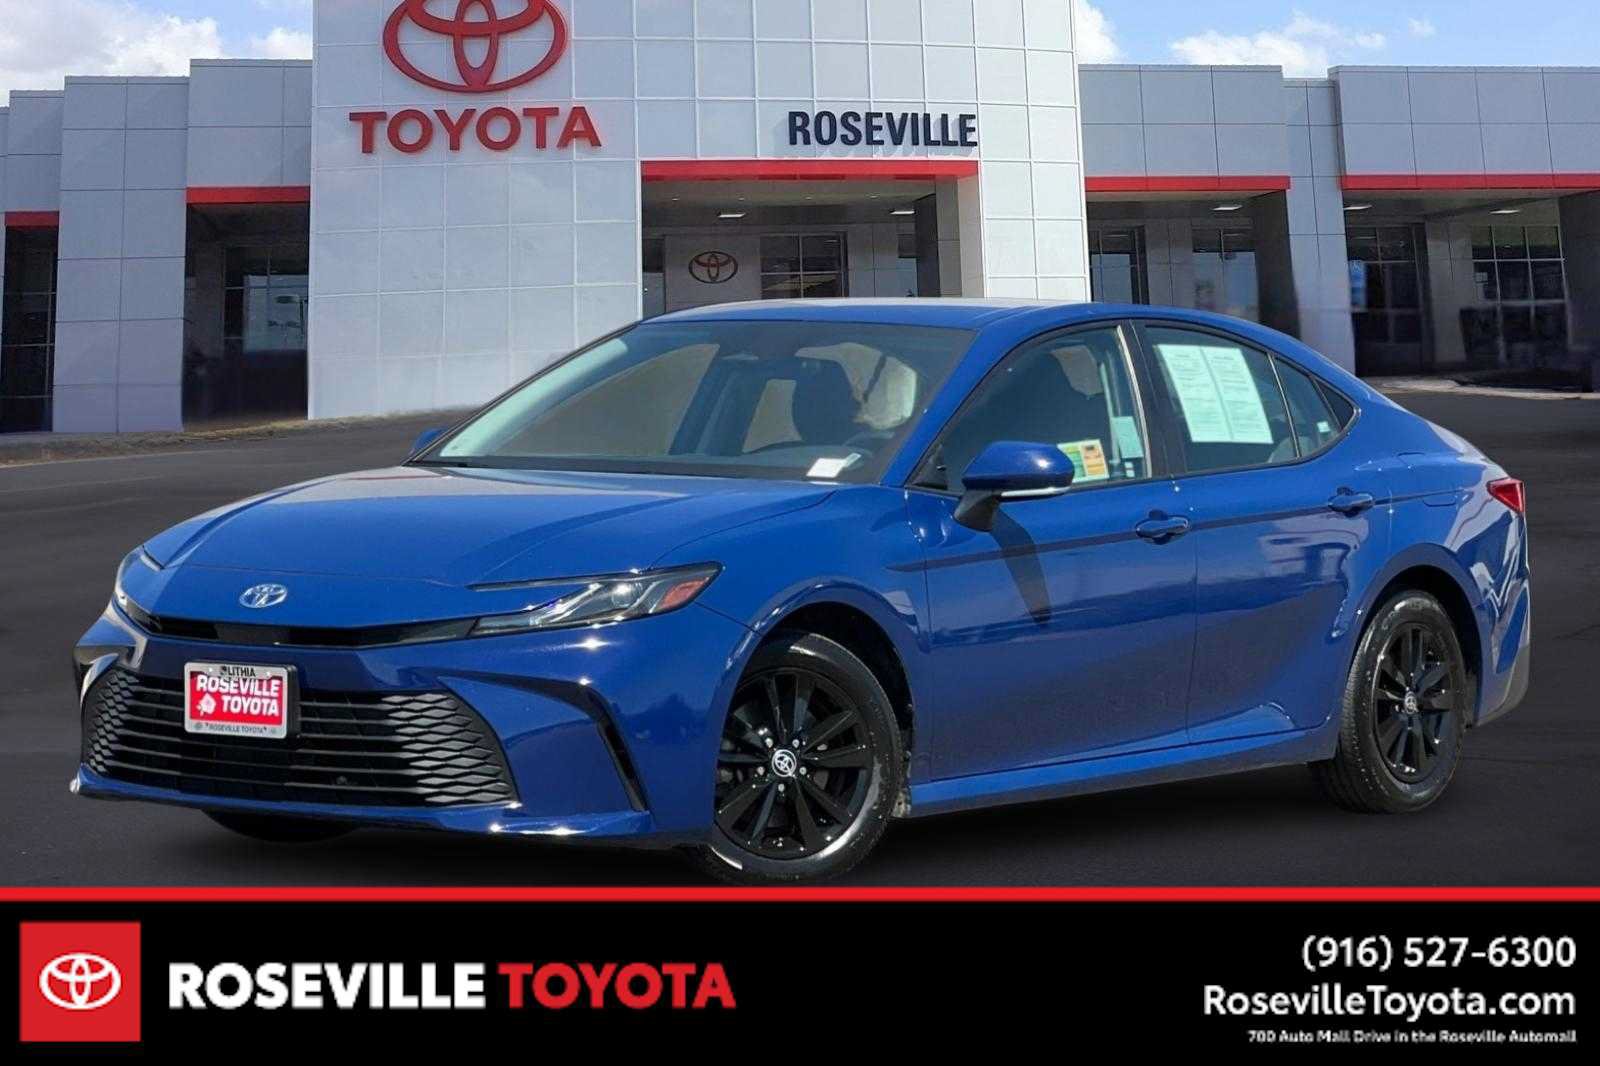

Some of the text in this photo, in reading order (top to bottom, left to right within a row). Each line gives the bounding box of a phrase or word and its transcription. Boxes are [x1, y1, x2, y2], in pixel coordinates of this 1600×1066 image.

[349, 106, 602, 154] TOYOTA
[788, 110, 978, 147] ROSEVILLE
[227, 666, 256, 677] LITHIA
[196, 674, 282, 697] ROSEVILLE
[221, 694, 280, 717] TOYOTA
